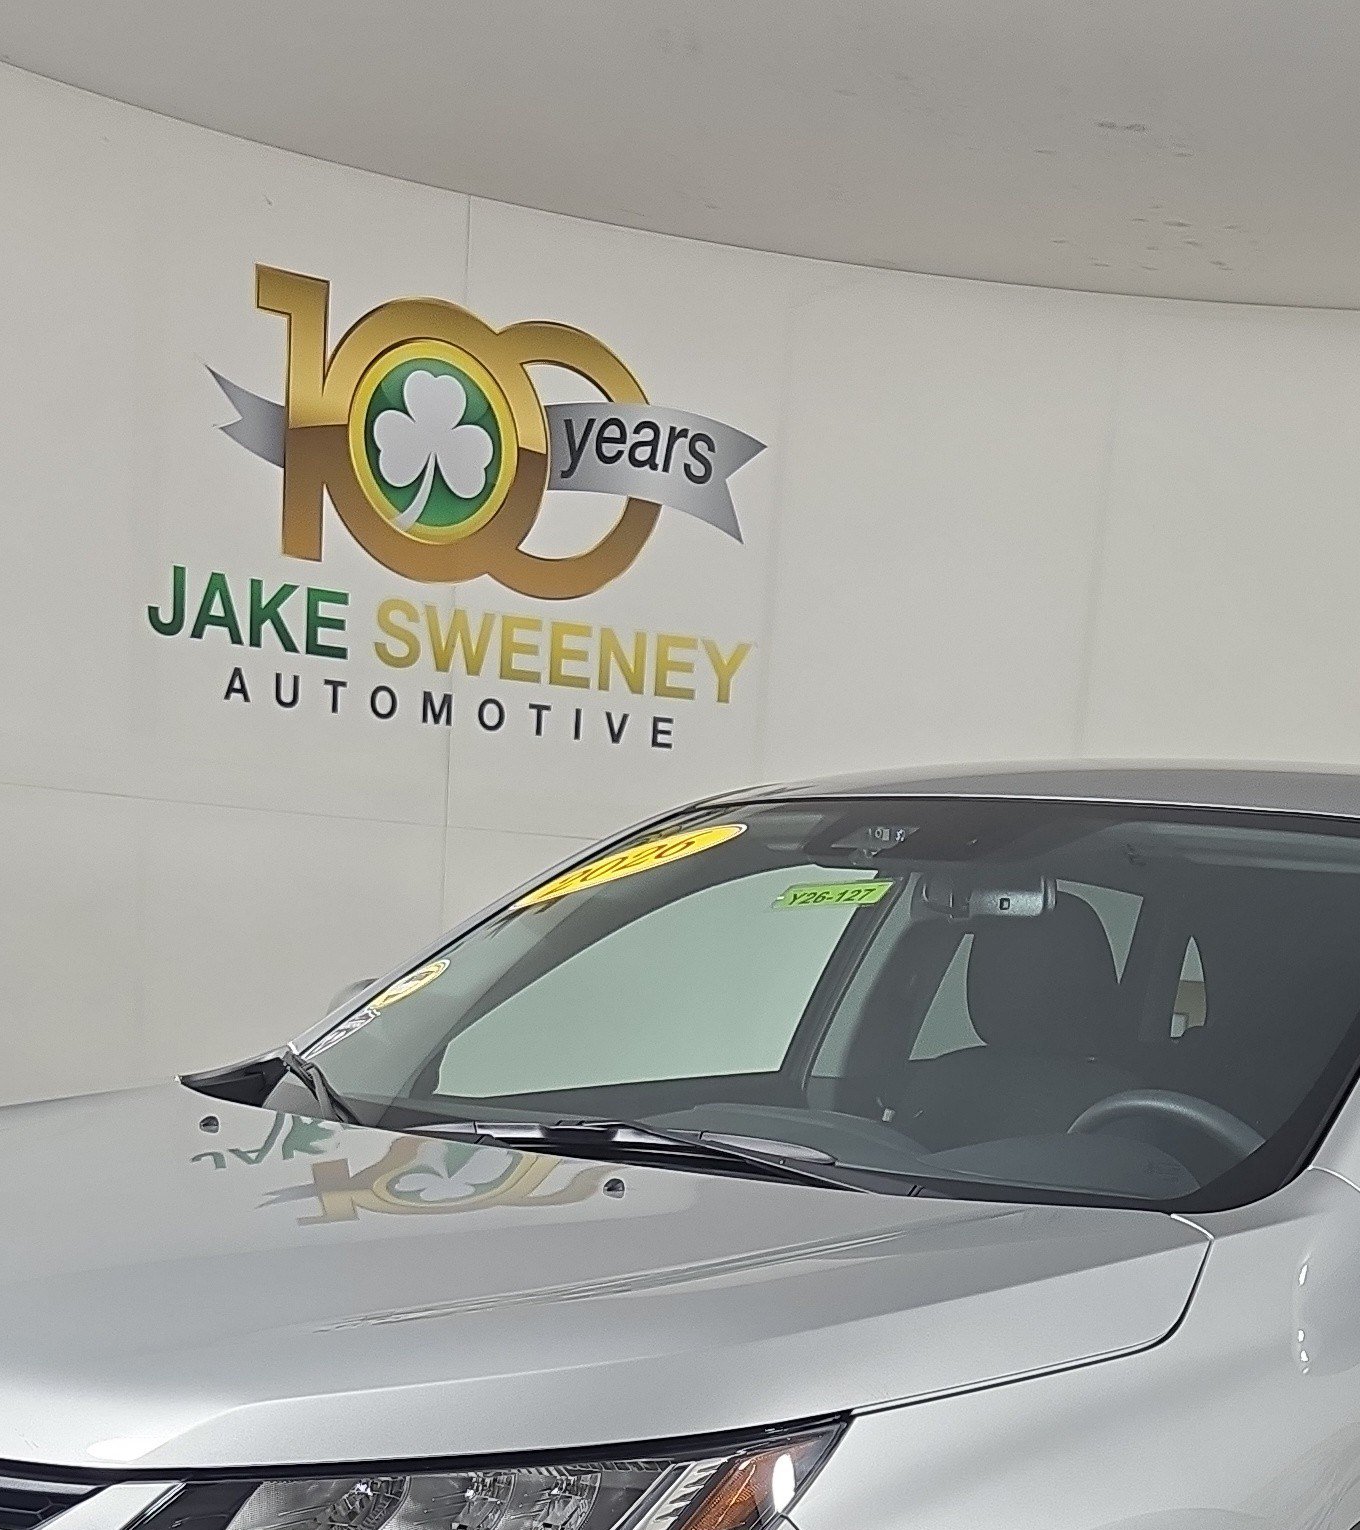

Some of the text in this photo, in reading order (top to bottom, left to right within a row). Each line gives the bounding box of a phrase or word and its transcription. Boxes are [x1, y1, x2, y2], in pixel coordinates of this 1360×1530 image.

[252, 262, 664, 602] 100
[560, 416, 718, 486] years
[147, 564, 753, 705] JAKE SWEENEY
[223, 666, 676, 751] AUTOMOTIVE
[537, 830, 713, 899] 2026
[788, 887, 877, 906] Y26-127
